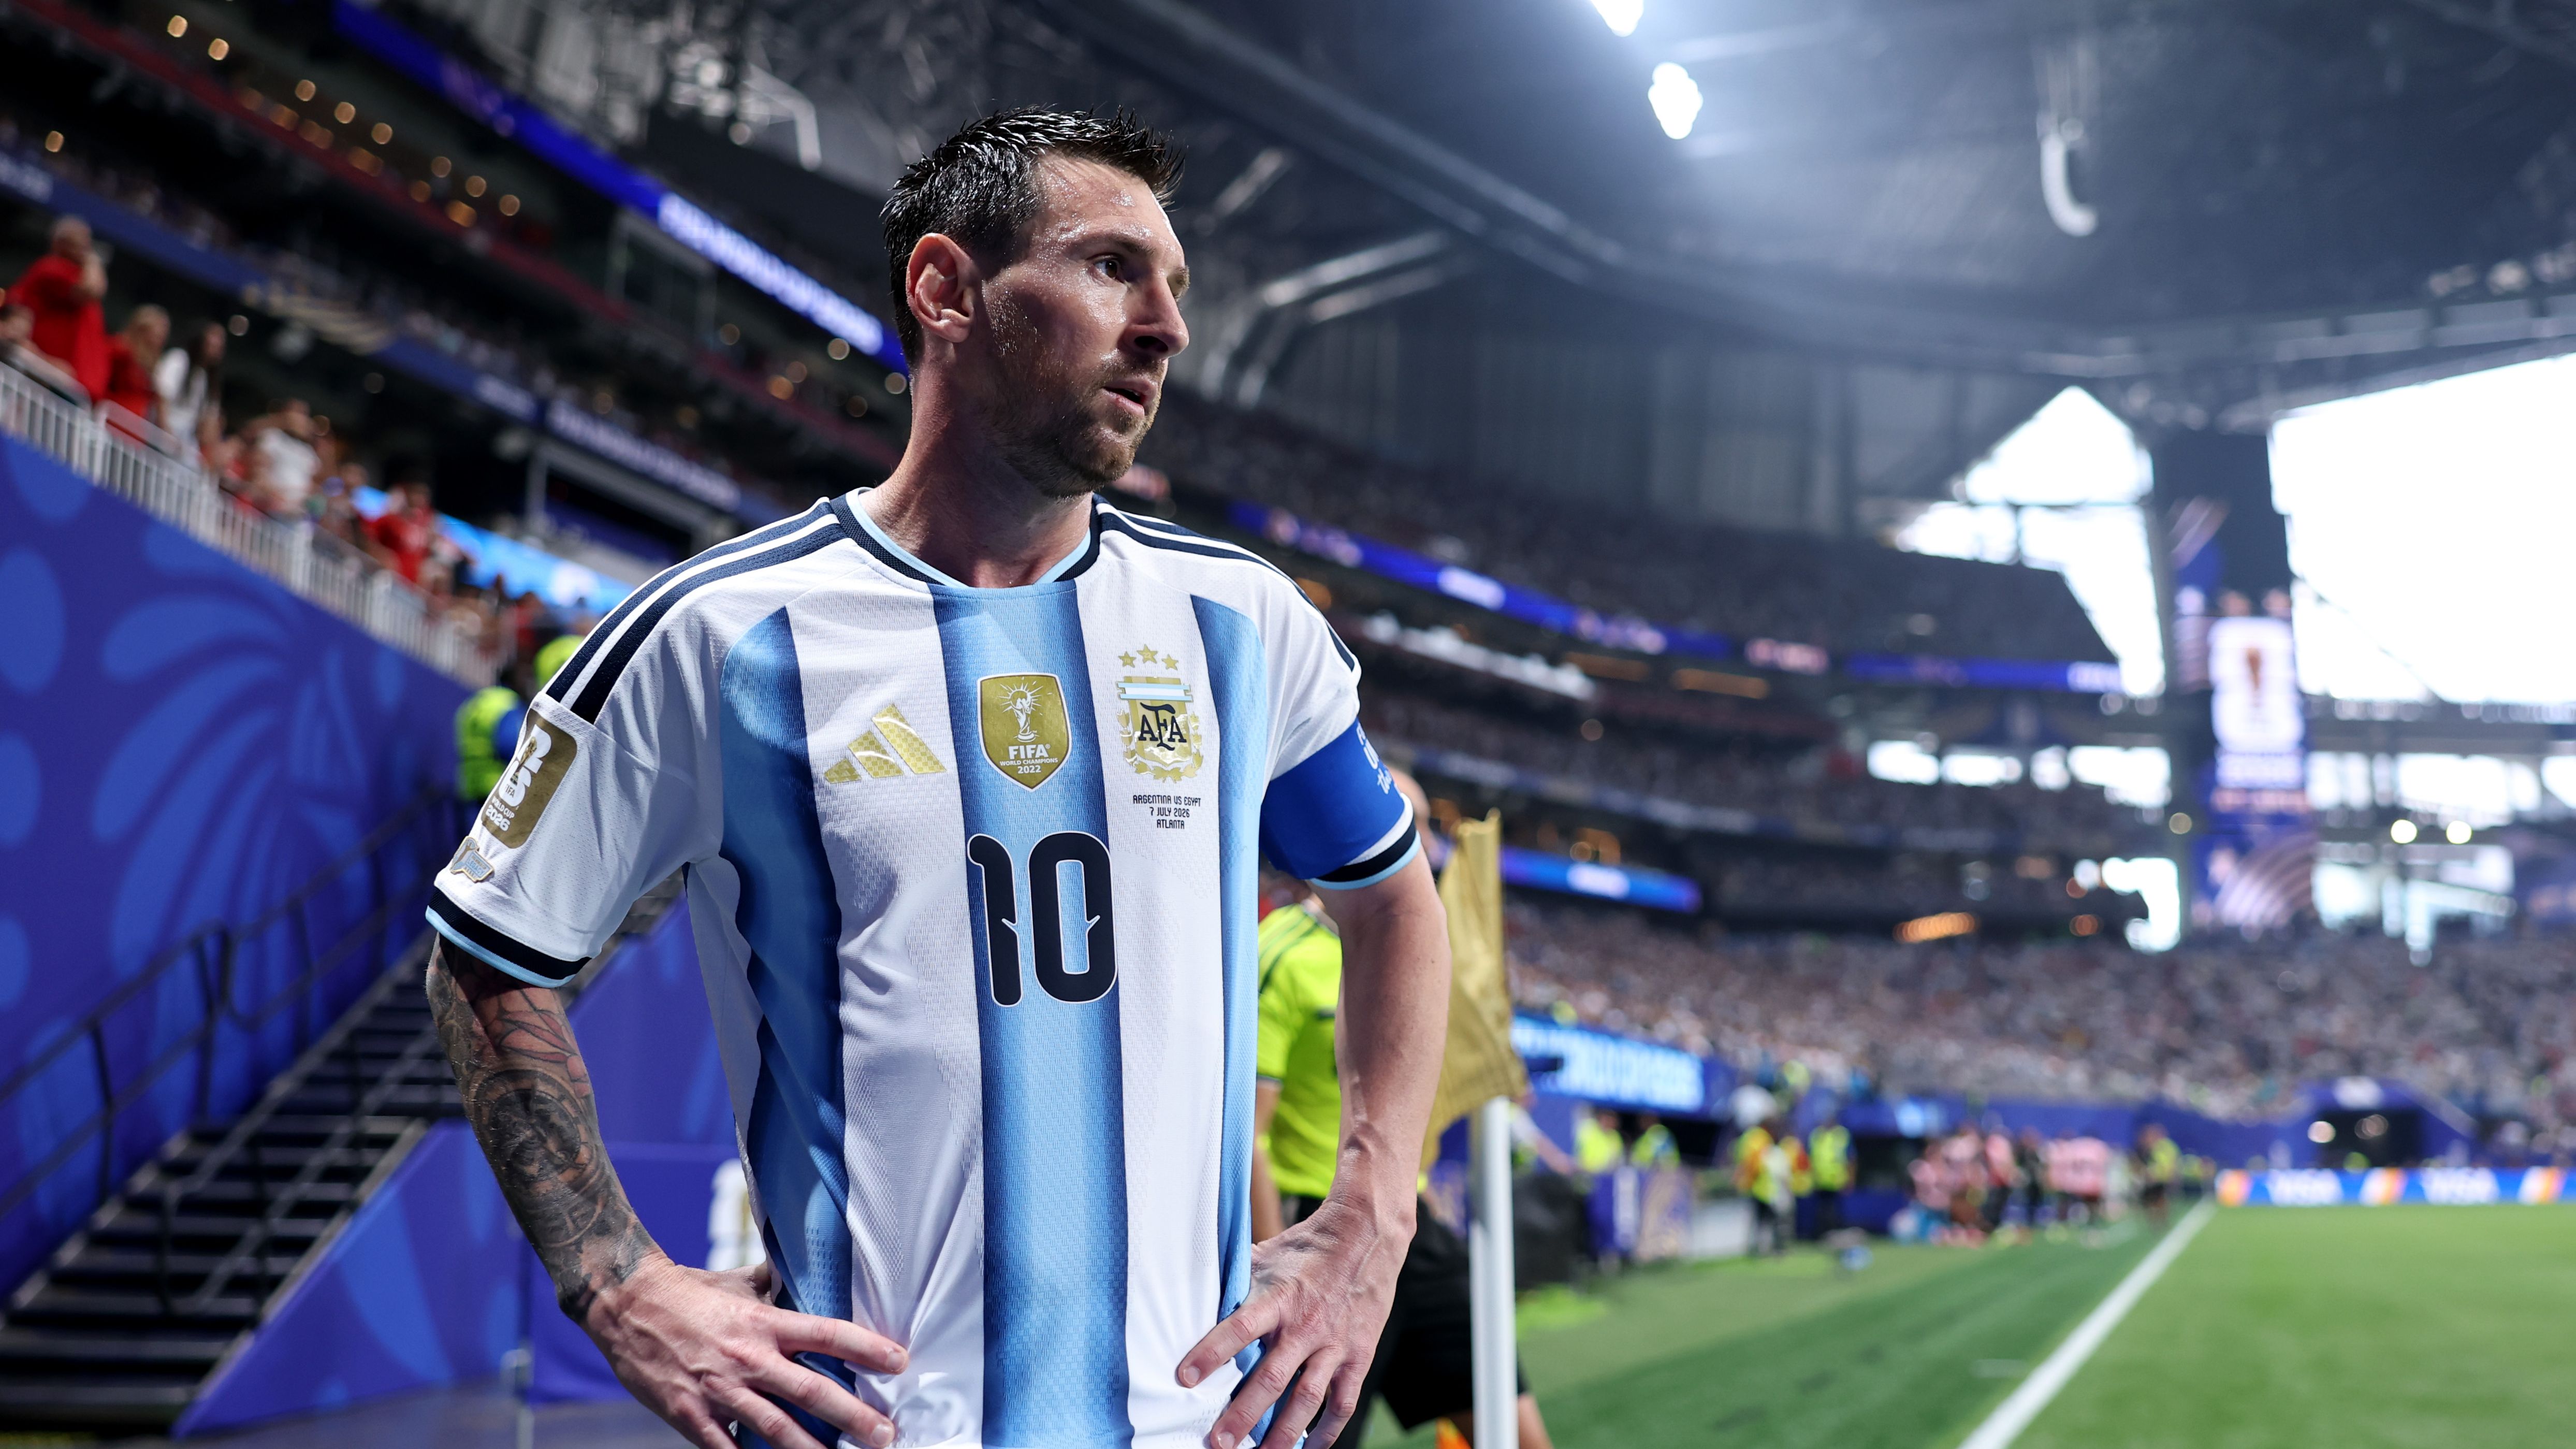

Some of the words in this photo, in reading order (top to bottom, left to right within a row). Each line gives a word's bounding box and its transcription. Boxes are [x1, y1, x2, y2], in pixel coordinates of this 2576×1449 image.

[1138, 702, 1187, 751] AFA
[1023, 757, 1058, 765] CHAMPIONS
[1017, 764, 1041, 774] 2022
[1133, 794, 1172, 804] ARGENTINA
[1184, 796, 1201, 807] EGYPT
[485, 804, 511, 831] 2026
[503, 808, 515, 819] CUP
[1149, 806, 1154, 816] 7
[1157, 807, 1172, 816] JULY
[1174, 808, 1190, 818] 2026
[1157, 819, 1185, 829] ATLANTA
[967, 830, 1118, 1007] 10
